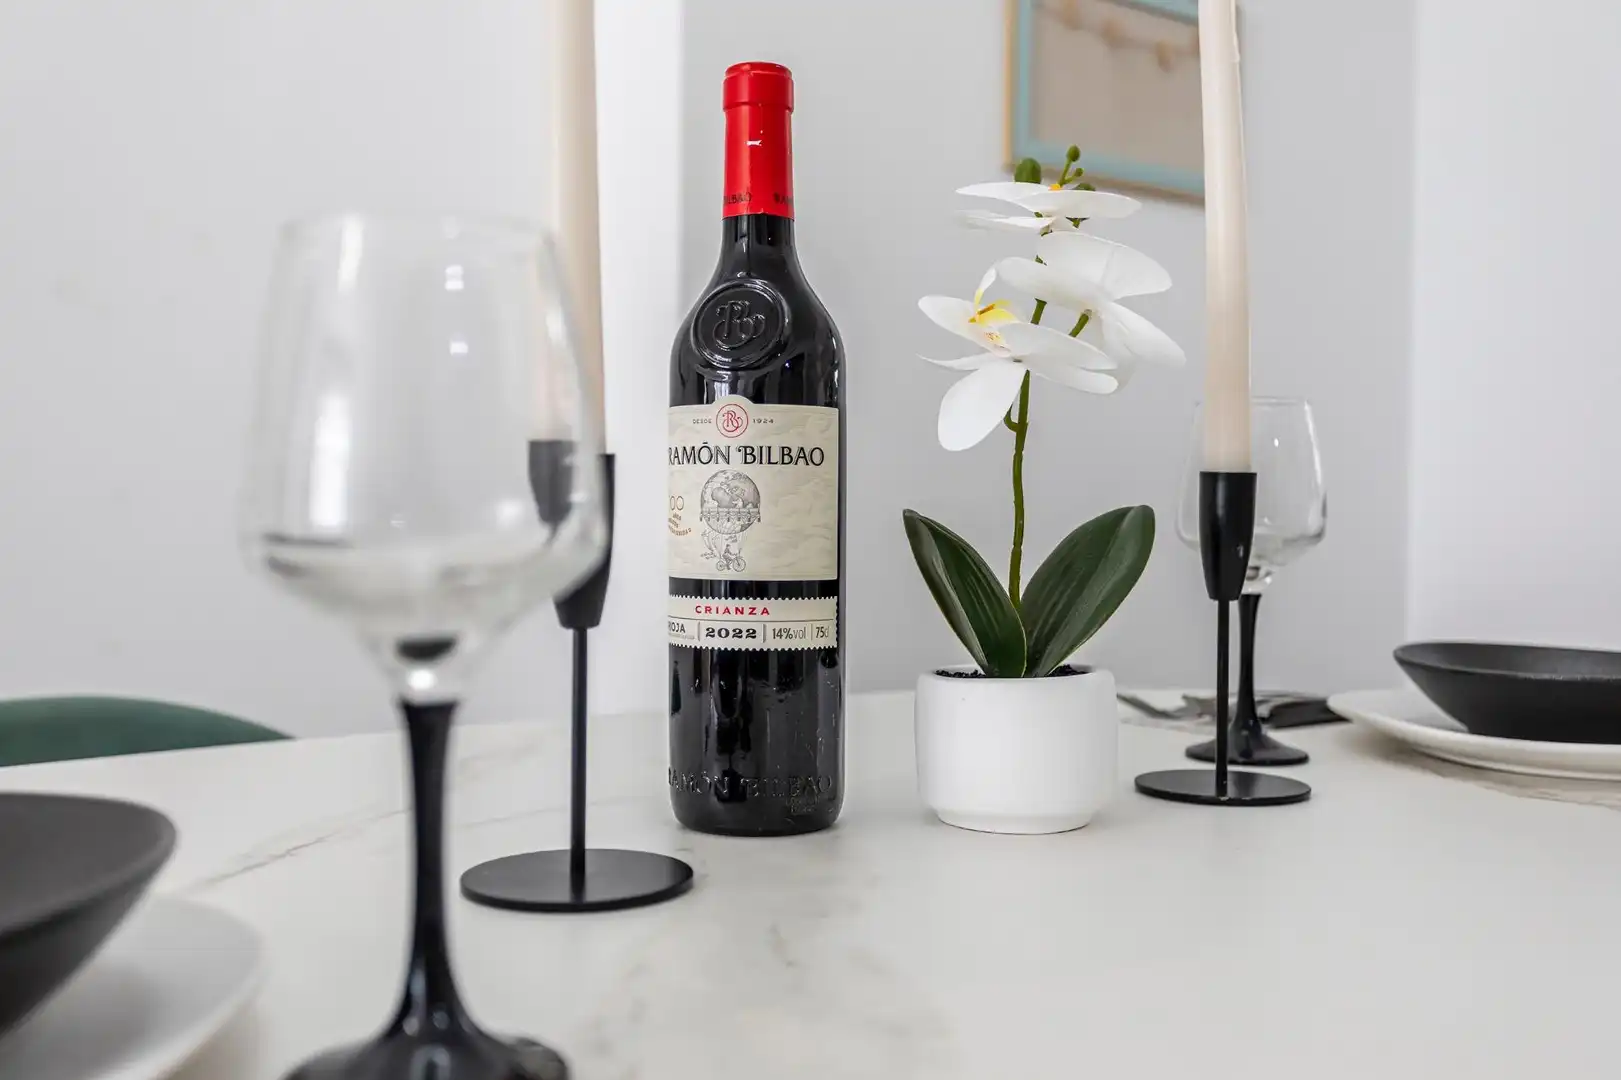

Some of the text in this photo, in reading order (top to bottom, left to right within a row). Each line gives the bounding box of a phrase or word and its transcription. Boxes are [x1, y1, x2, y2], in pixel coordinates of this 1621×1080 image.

[752, 417, 775, 425] 1924
[735, 445, 825, 467] BILBAO
[695, 605, 770, 616] CRIANZA
[705, 627, 757, 640] 2022
